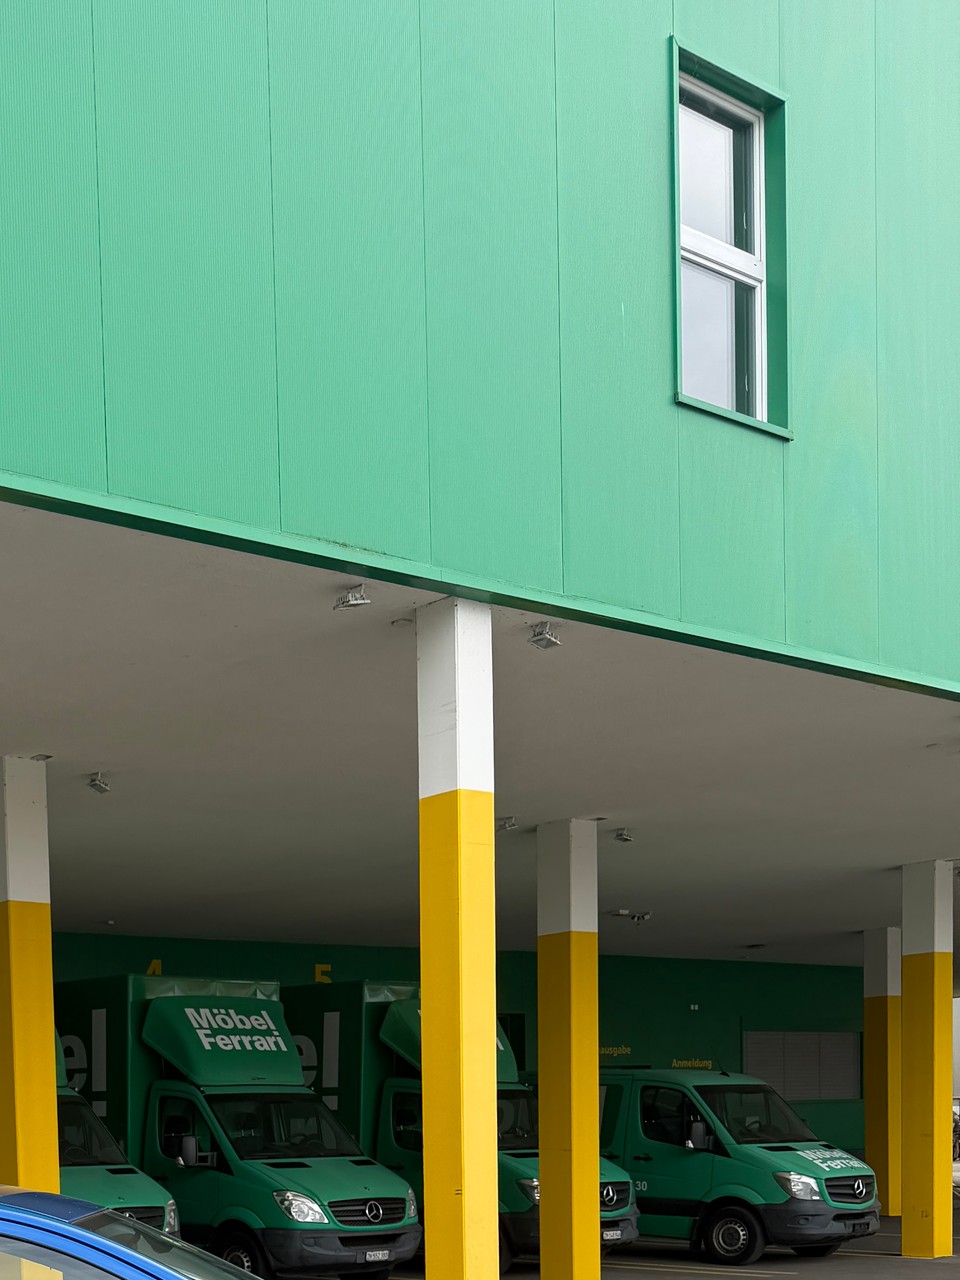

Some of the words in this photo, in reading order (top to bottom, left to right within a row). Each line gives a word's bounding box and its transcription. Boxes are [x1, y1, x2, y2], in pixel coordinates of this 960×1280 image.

[184, 1007, 276, 1031] Möbel
[195, 1029, 288, 1051] Ferrari
[599, 1045, 632, 1057] ausgabe
[671, 1058, 713, 1069] Anmeldung
[635, 1181, 648, 1192] 30
